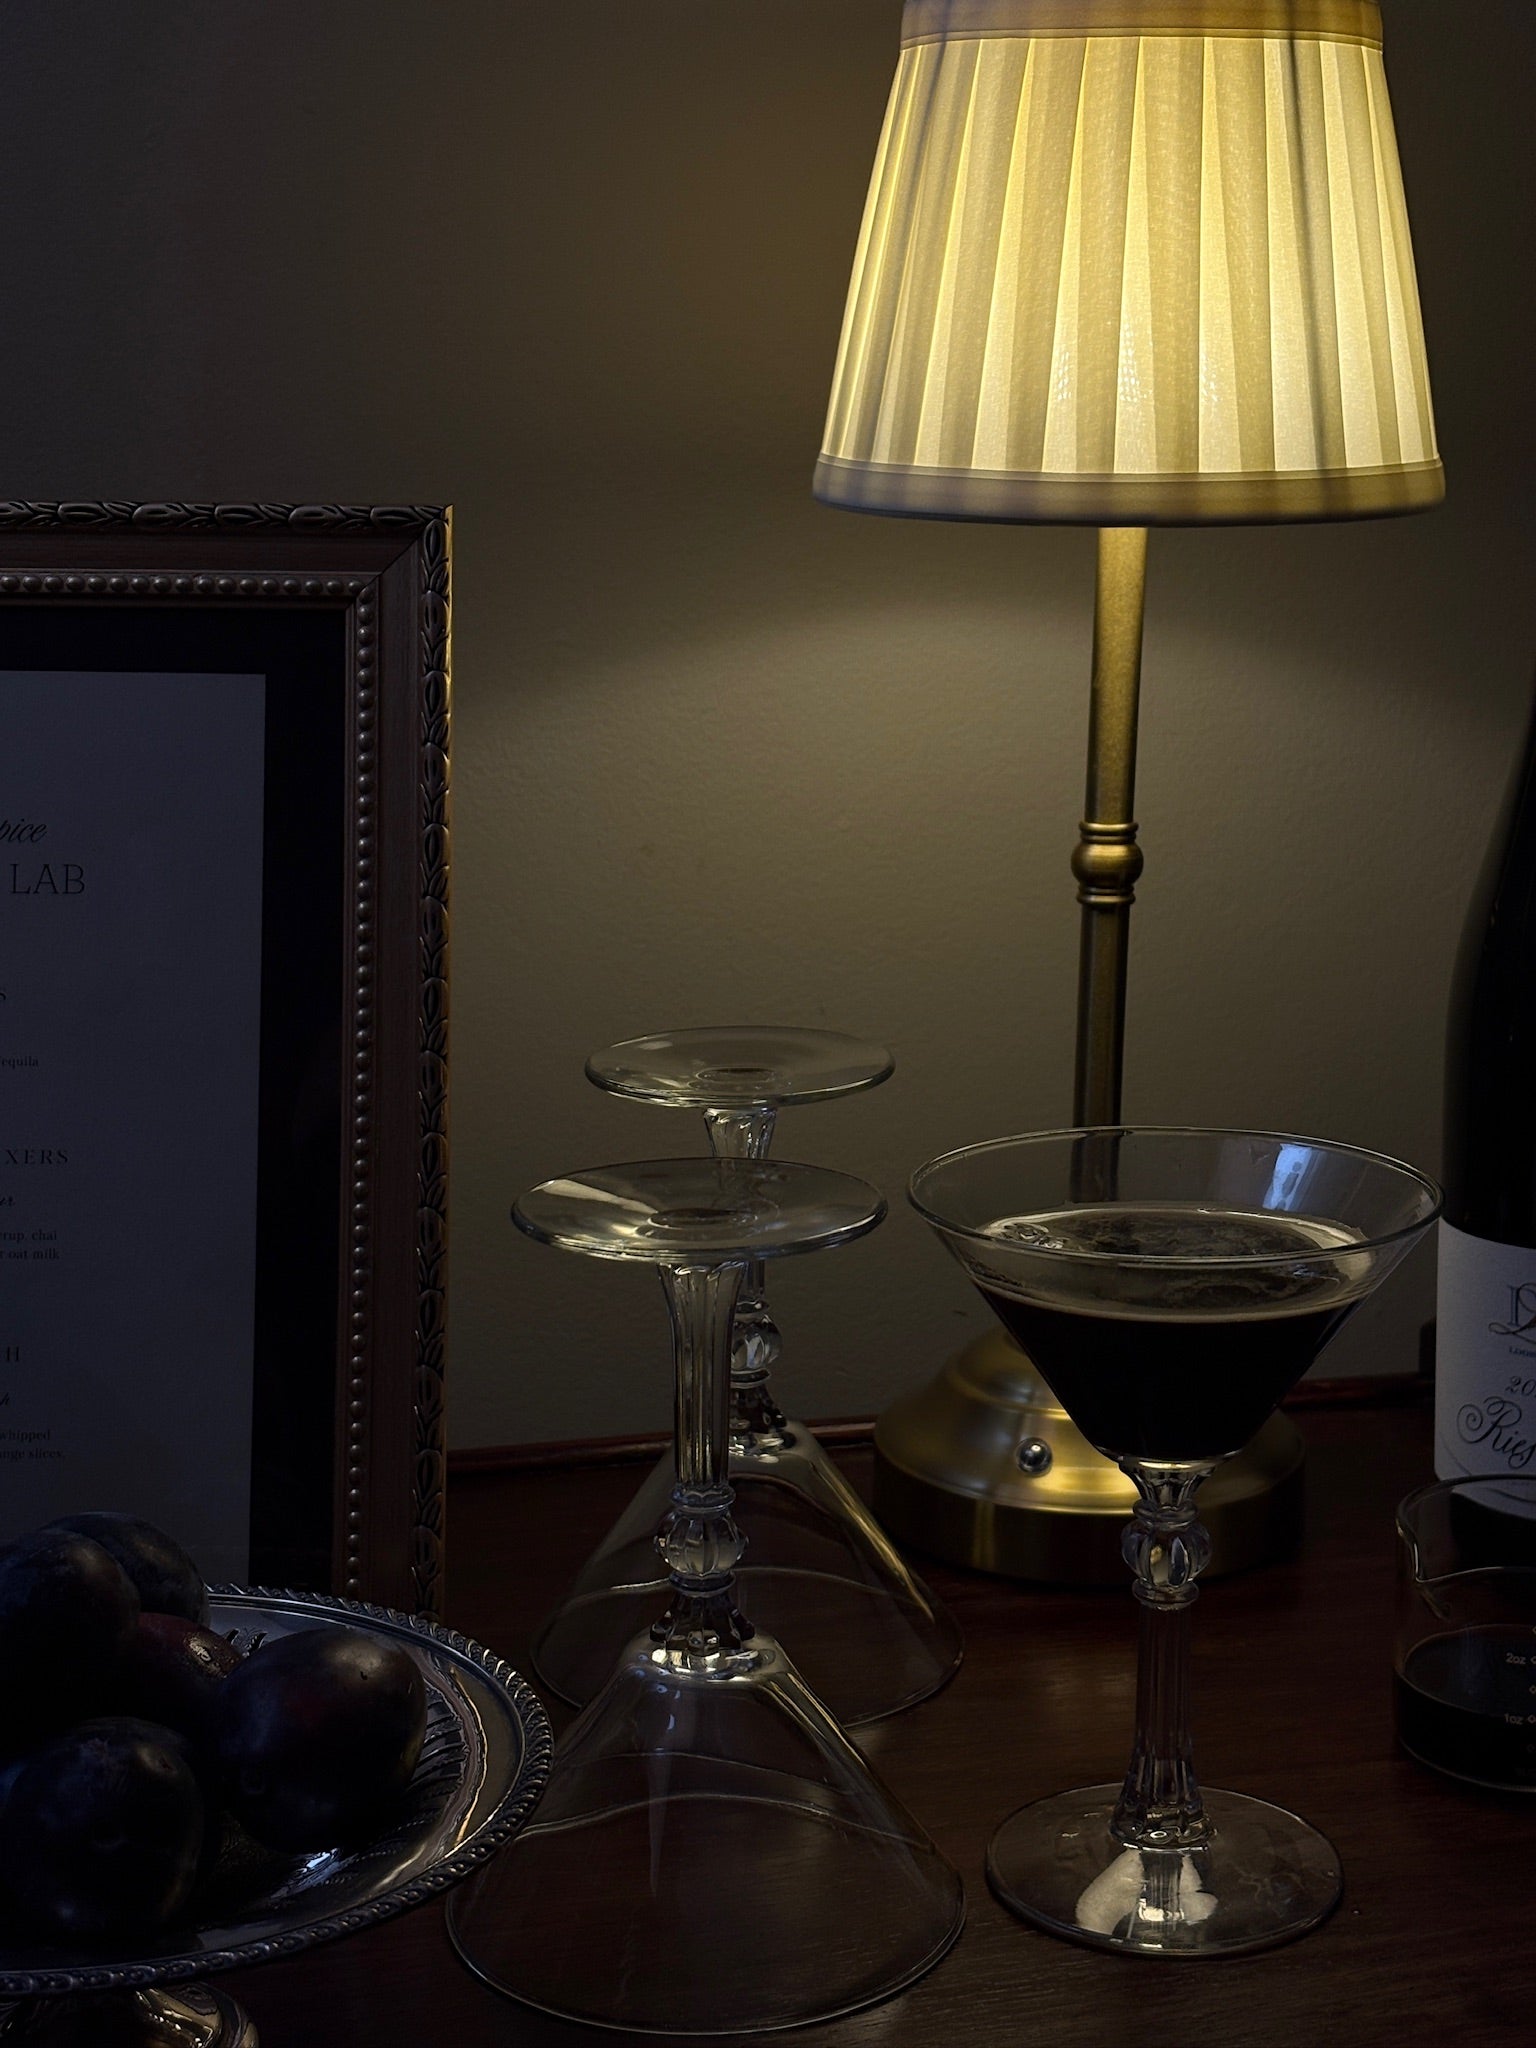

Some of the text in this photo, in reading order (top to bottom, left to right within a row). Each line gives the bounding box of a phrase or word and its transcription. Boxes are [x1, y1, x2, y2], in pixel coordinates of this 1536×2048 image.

[9, 863, 86, 895] LAB
[0, 1055, 39, 1070] equila
[33, 1248, 60, 1260] milk
[1504, 1376, 1536, 1397] 20
[1505, 1652, 1526, 1665] 2oz
[1504, 1713, 1524, 1725] 1oz
